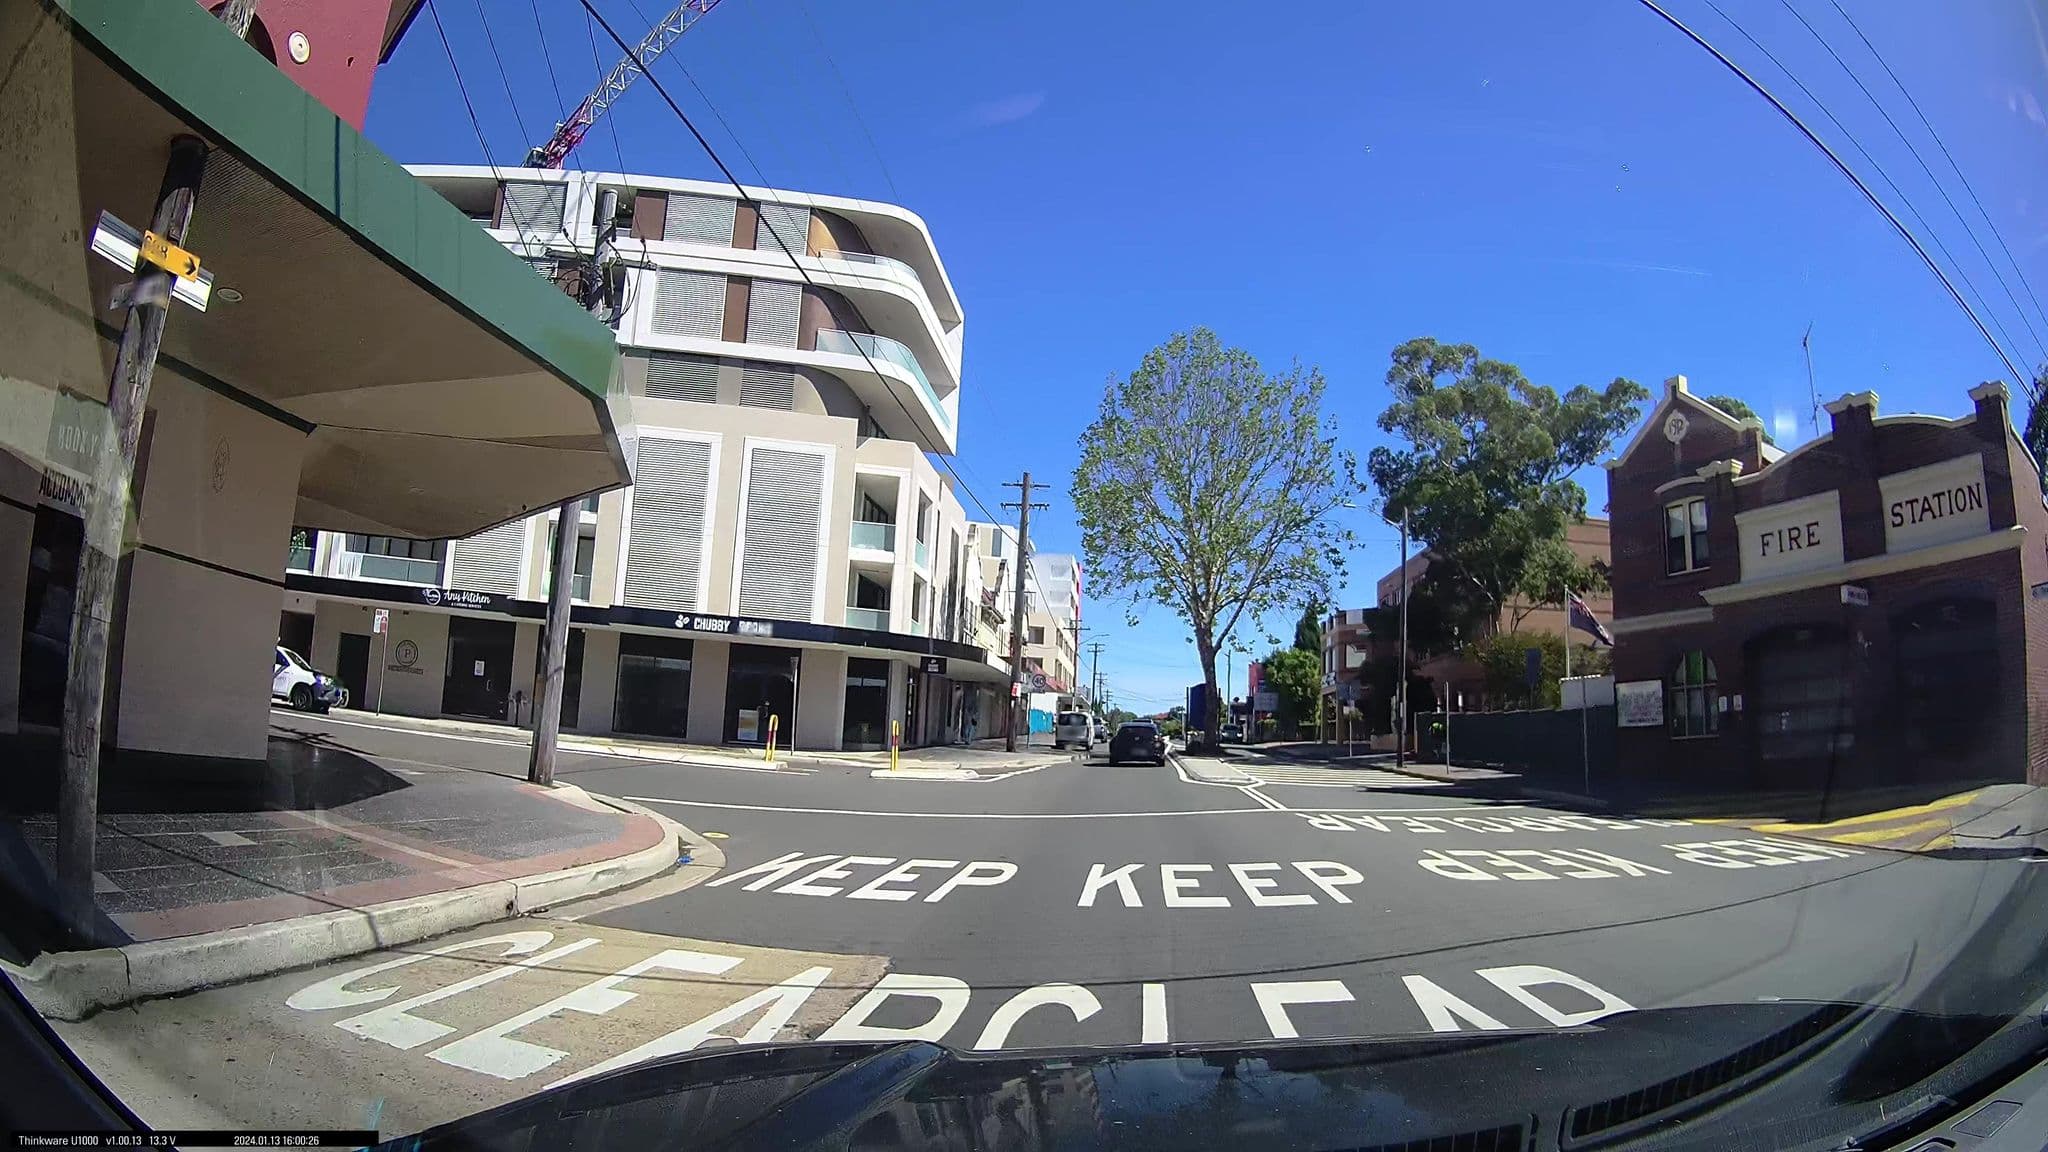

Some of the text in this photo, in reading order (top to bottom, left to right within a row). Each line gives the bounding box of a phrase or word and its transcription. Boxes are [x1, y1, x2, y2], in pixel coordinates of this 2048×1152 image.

[1760, 483, 1983, 557] FIRE STATION
[693, 617, 731, 632] CHUBBY
[708, 851, 1366, 907] KEEP KEEP
[1417, 837, 1866, 880] KEEP KEEP
